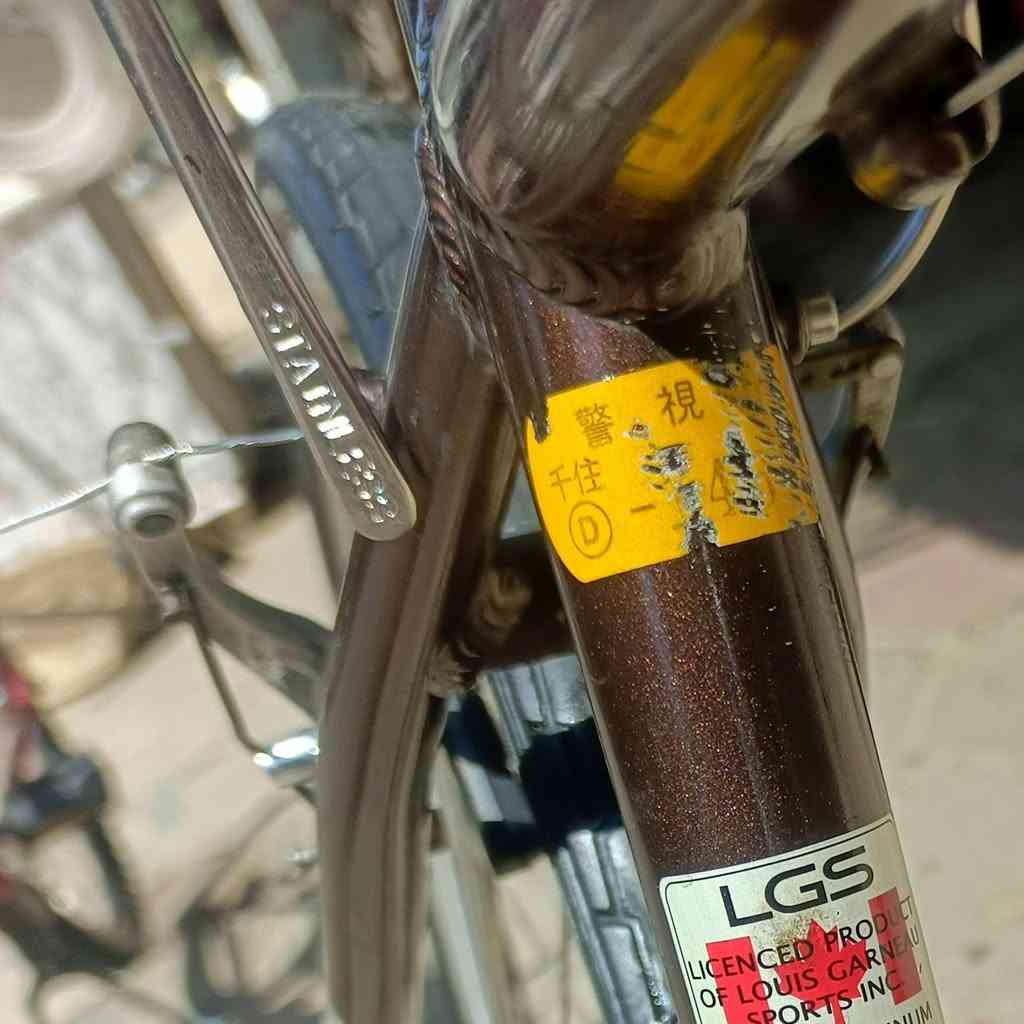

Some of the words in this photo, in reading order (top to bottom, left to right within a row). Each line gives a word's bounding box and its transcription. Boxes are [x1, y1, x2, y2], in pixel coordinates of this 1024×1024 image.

[549, 458, 605, 500] 千住
[719, 845, 875, 928] LGS
[687, 938, 815, 981] LICENCED
[700, 987, 728, 1009] OF
[736, 969, 819, 1005] LOUIS
